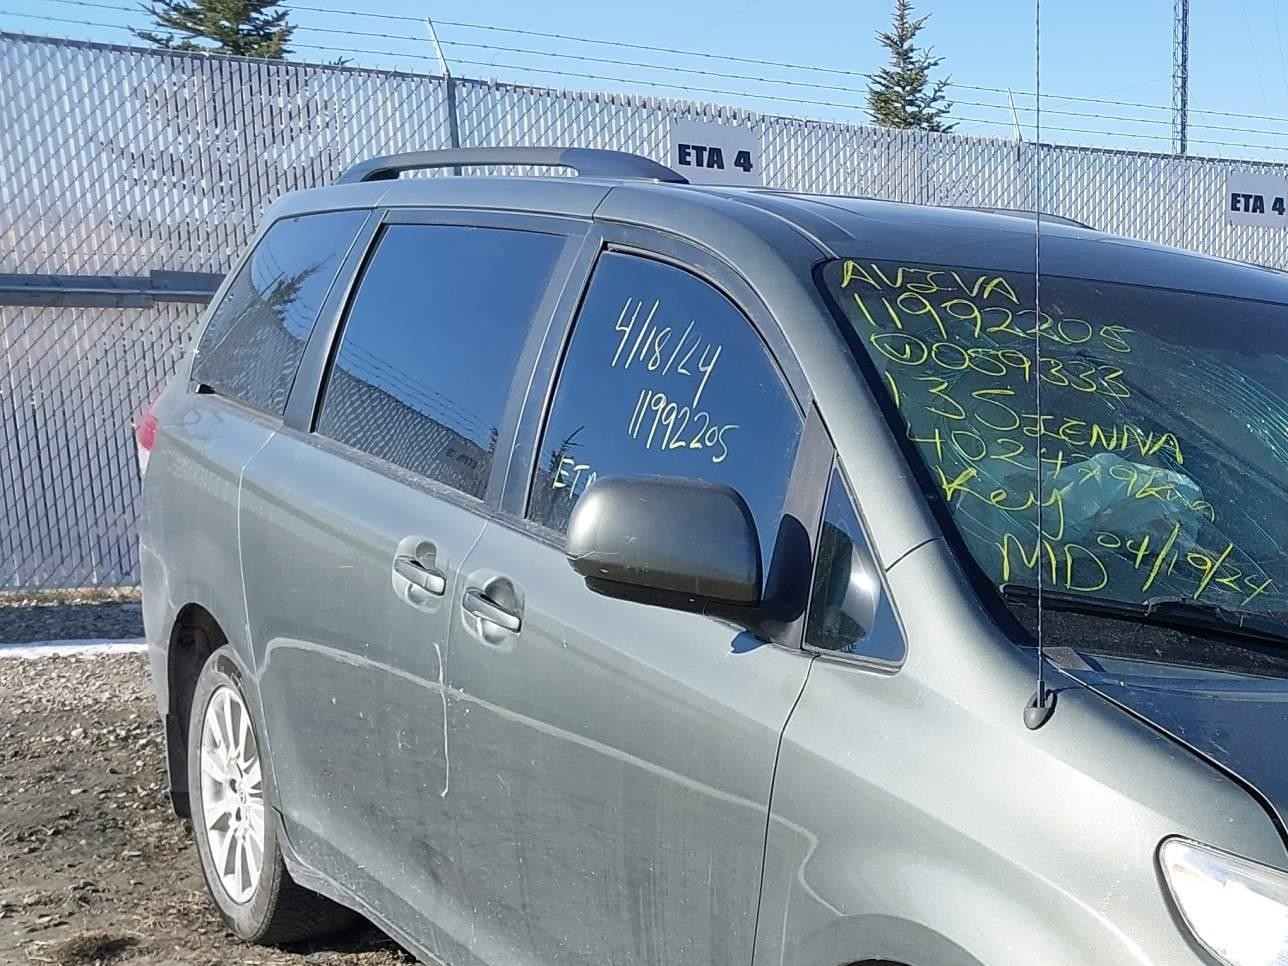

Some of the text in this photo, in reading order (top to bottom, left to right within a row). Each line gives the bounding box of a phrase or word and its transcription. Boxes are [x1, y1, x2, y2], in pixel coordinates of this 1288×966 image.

[678, 143, 753, 173] ETA 4
[1230, 192, 1286, 216] ETA 4
[841, 260, 1020, 305] AVIVA
[854, 292, 1136, 352] 11992205
[611, 296, 723, 409] 4/18/24
[628, 389, 741, 463] 11992205
